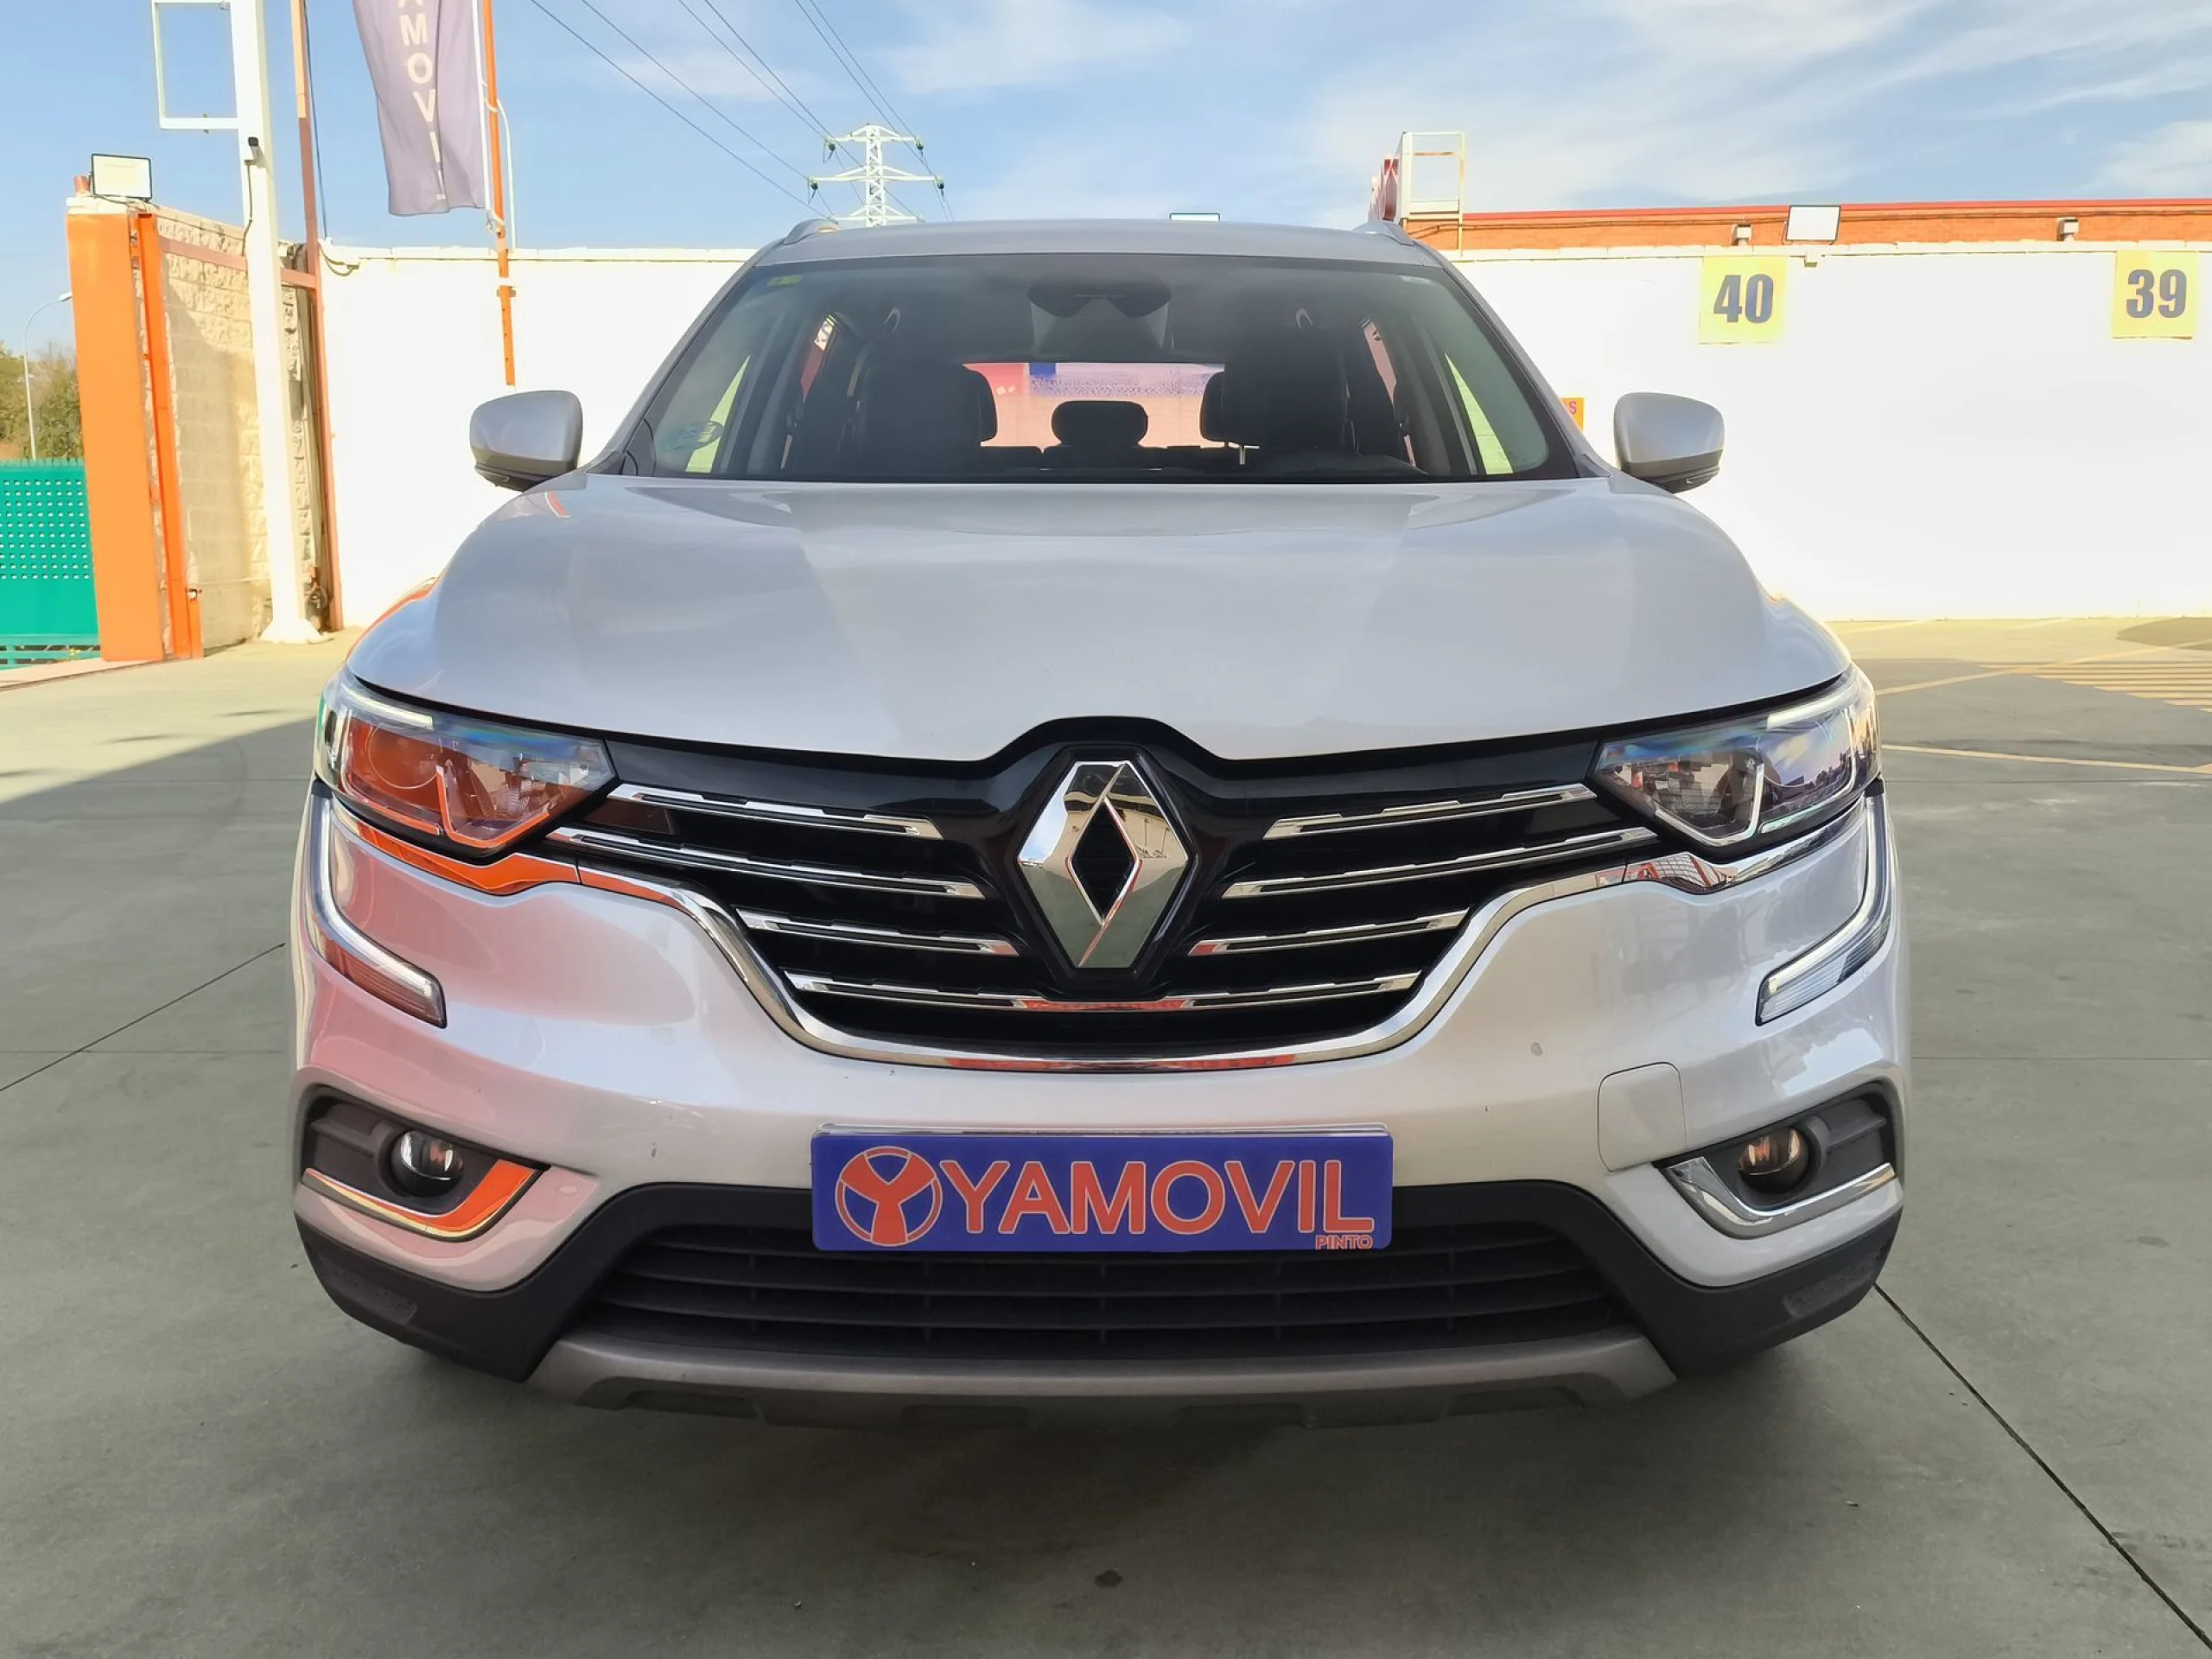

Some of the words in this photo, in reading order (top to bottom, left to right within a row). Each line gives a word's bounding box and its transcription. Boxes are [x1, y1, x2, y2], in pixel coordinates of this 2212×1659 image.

[1713, 273, 1774, 323] 40
[2126, 269, 2188, 319] 39
[940, 1160, 1375, 1235] YAMOVIL
[1315, 1234, 1373, 1250] PINTO
